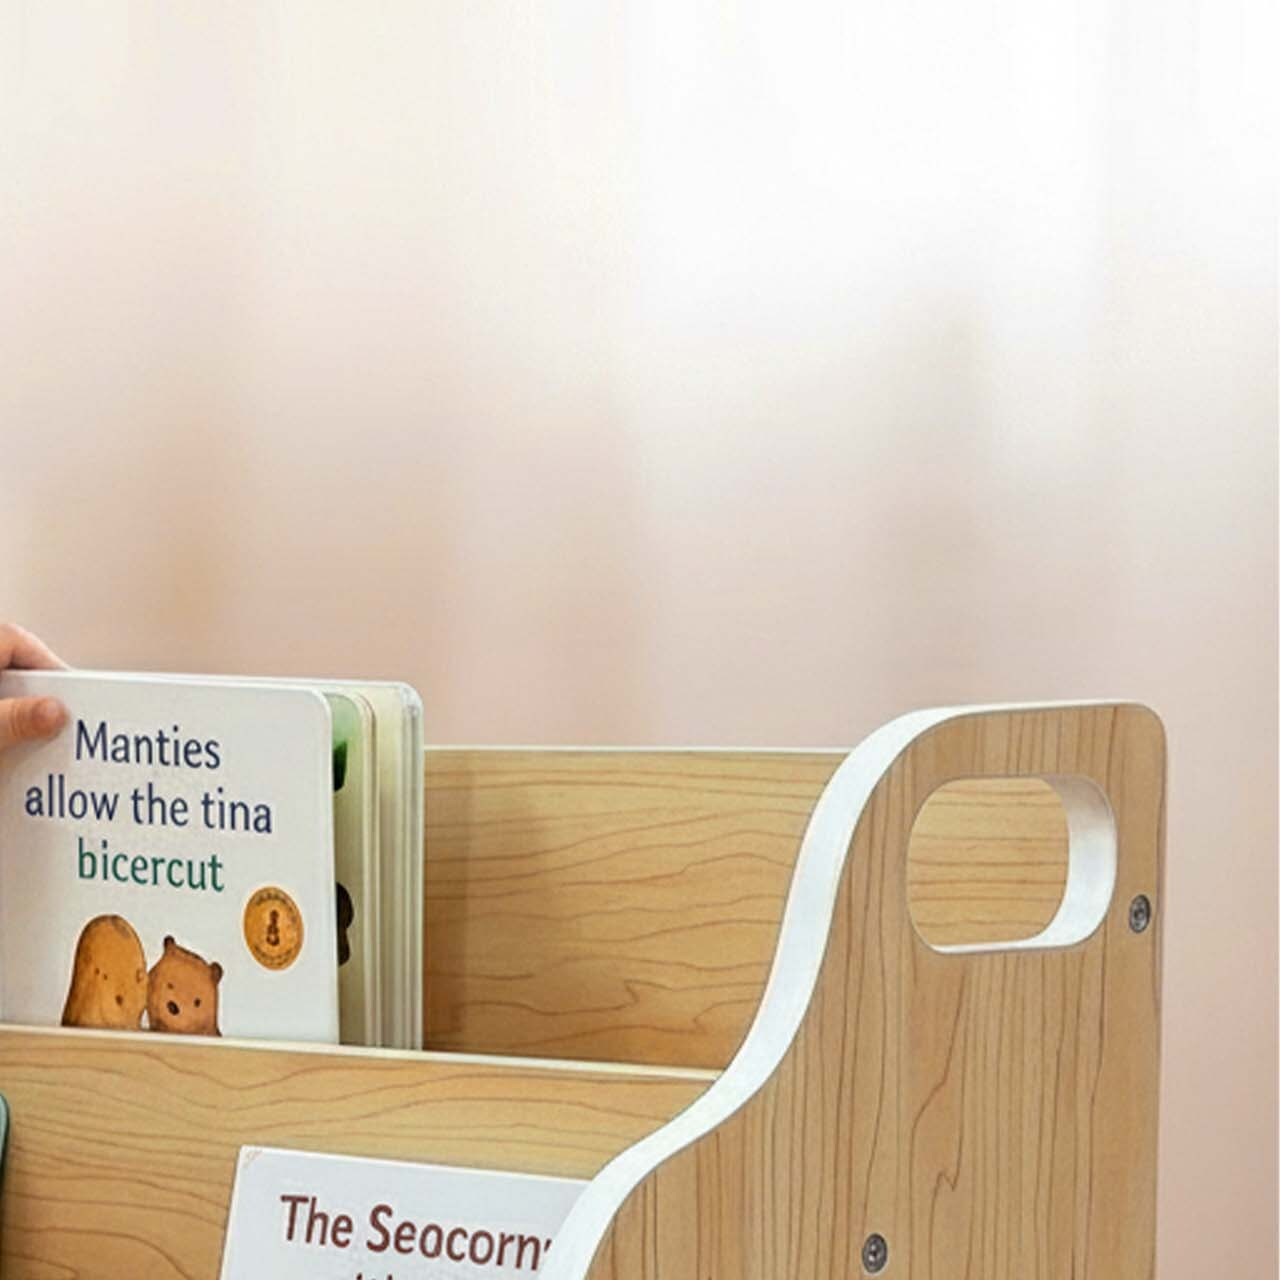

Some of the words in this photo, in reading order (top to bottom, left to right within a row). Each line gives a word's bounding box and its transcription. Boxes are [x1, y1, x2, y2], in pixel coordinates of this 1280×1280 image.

[76, 719, 221, 770] Manties
[25, 774, 119, 820] allow
[131, 782, 188, 827] the
[201, 787, 272, 833] tina
[78, 837, 224, 892] bicercut
[280, 1195, 353, 1248] The
